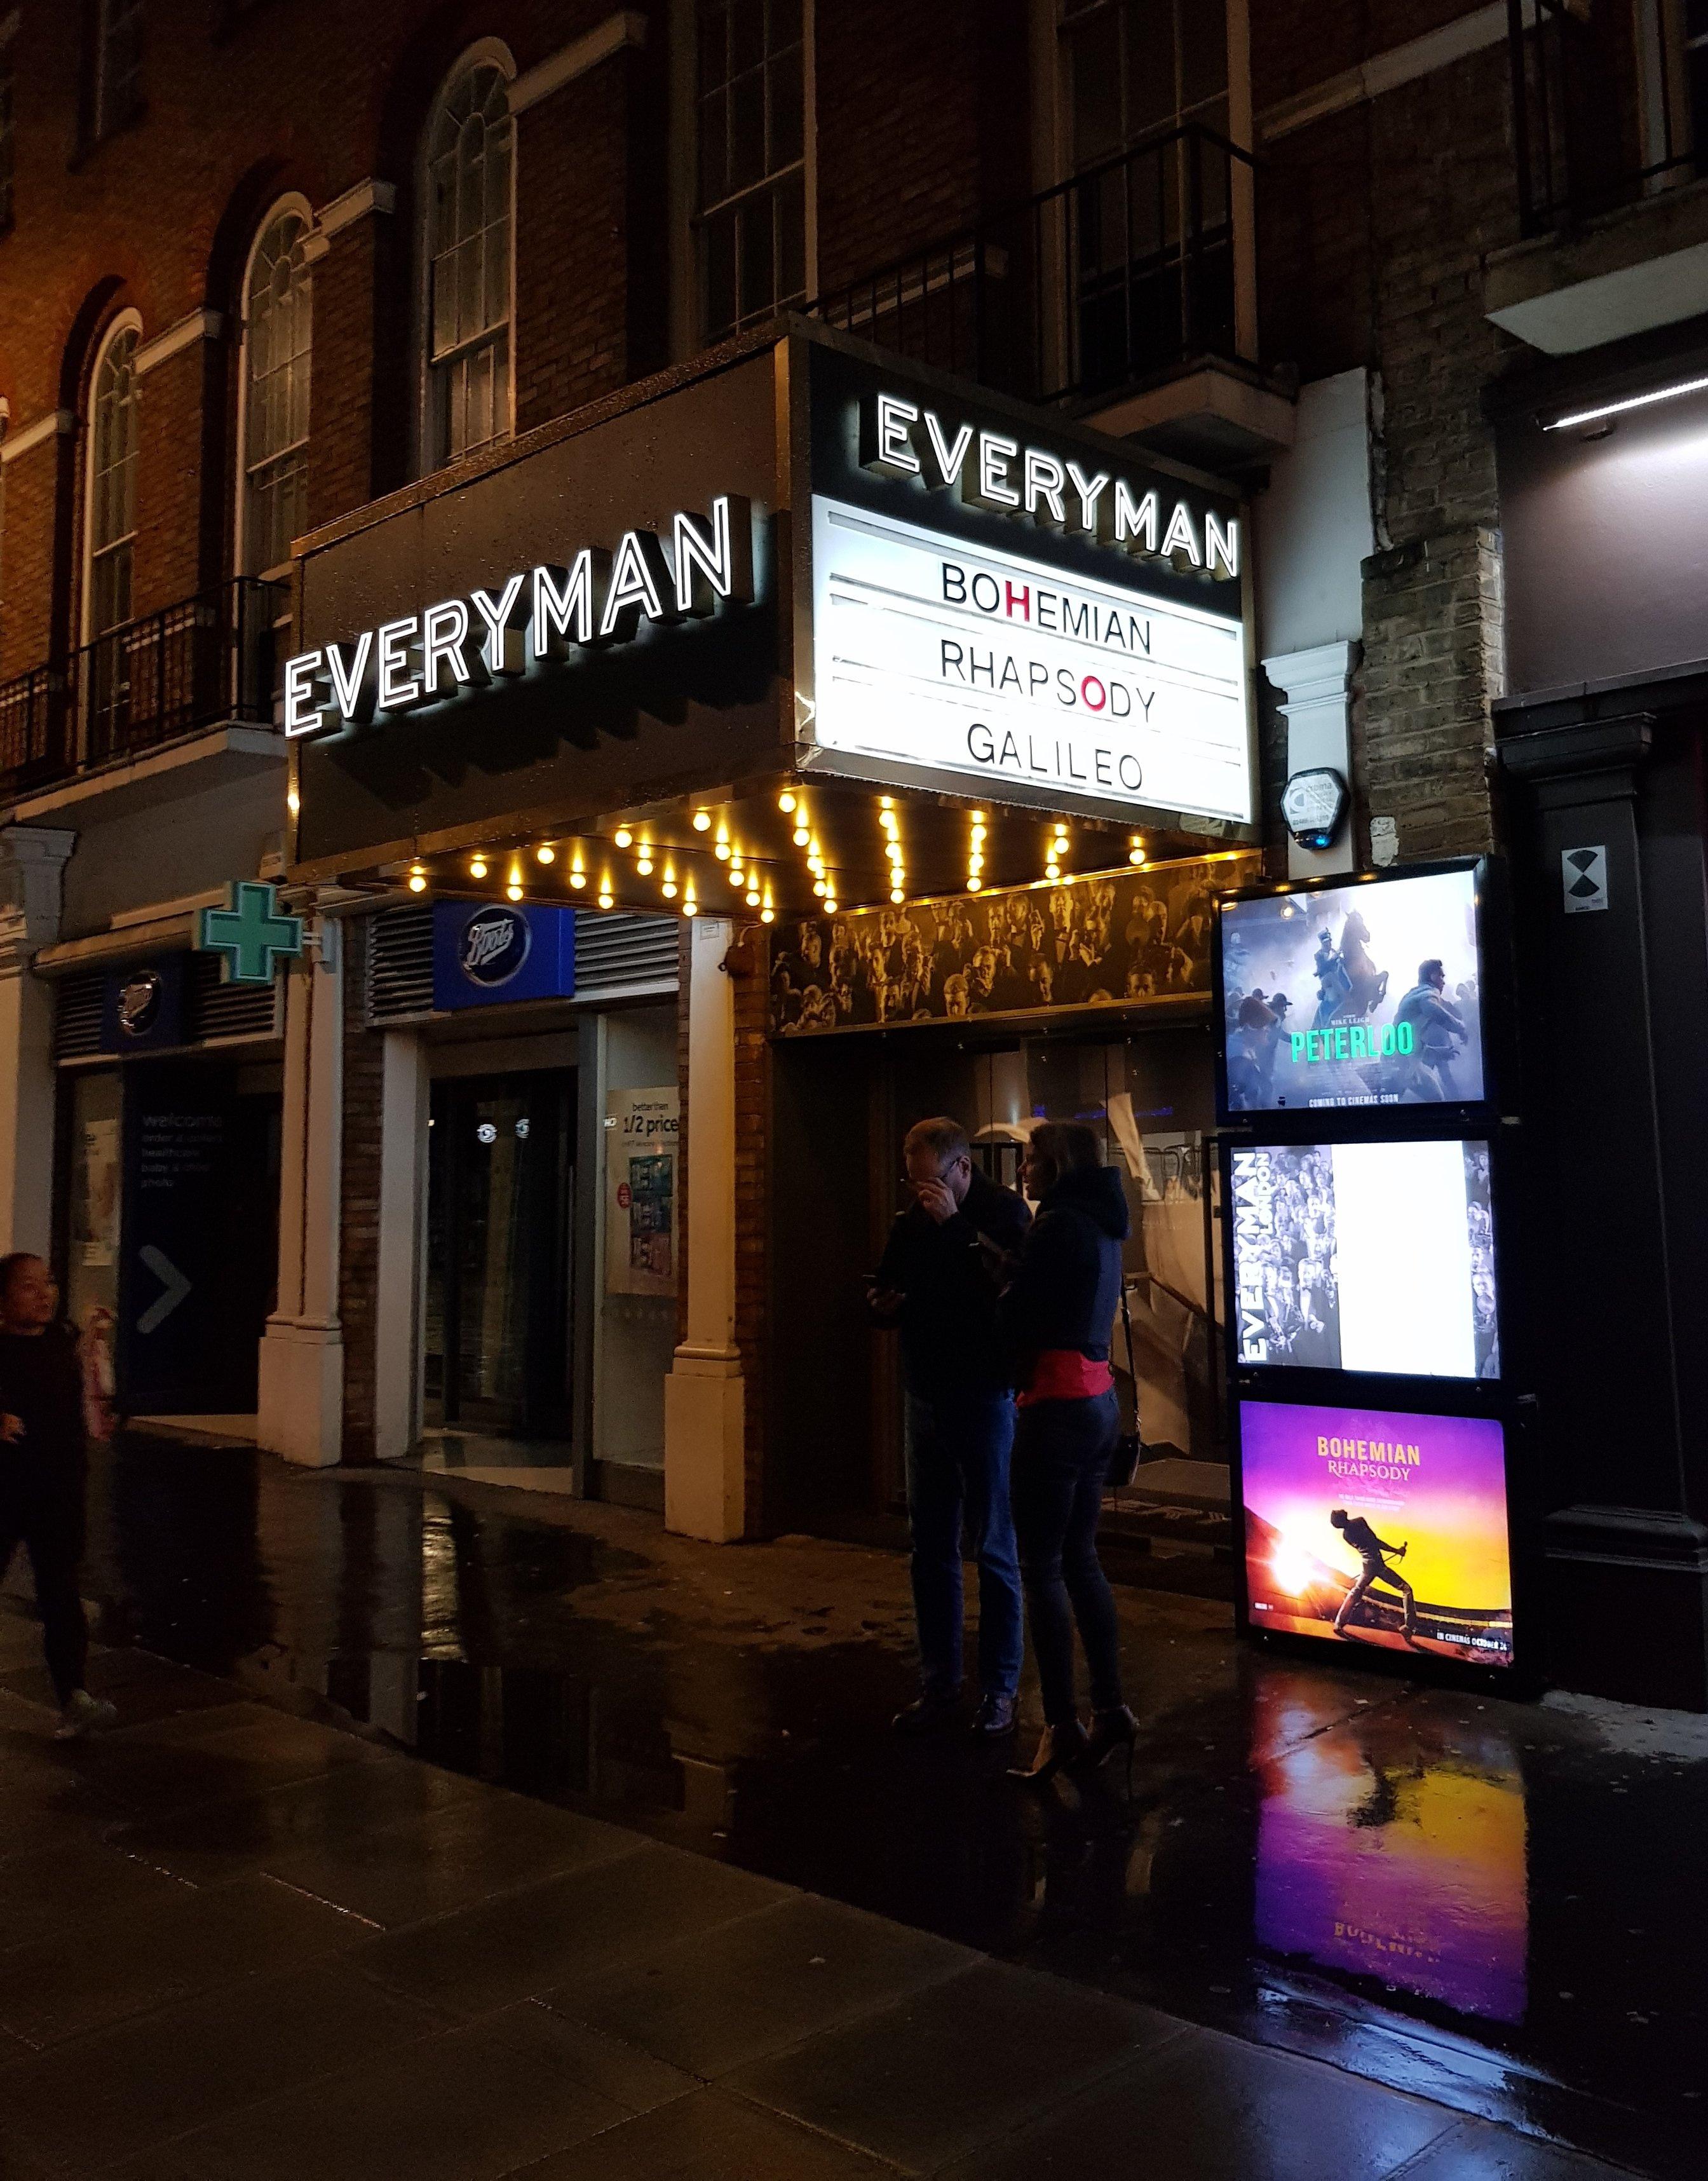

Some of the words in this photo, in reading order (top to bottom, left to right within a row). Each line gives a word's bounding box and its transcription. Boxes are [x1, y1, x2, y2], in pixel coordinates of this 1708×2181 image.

[878, 395, 1238, 578] EVERYMAN
[285, 496, 732, 740] EVERYMAN
[942, 561, 1151, 655] BOHEMIAN
[940, 639, 1156, 723] RHAPSODY
[966, 723, 1142, 791] GALILEO
[1291, 1021, 1414, 1063] PETERLOO
[624, 1115, 643, 1133] 1/2
[647, 1113, 679, 1138] price
[1309, 1097, 1334, 1108] COMING
[1336, 1097, 1346, 1106] TO
[1348, 1095, 1378, 1104] CINEMAS
[1380, 1094, 1399, 1103] SOON
[1256, 1152, 1273, 1235] LONDON
[1233, 1152, 1268, 1362] EVERYMAN
[1317, 1436, 1421, 1466] BOHEMIAN
[1327, 1460, 1412, 1481] RHAPSODY
[1437, 1631, 1444, 1640] IN
[1445, 1633, 1471, 1645] CINEMAS
[1472, 1638, 1499, 1650] OCTOBER
